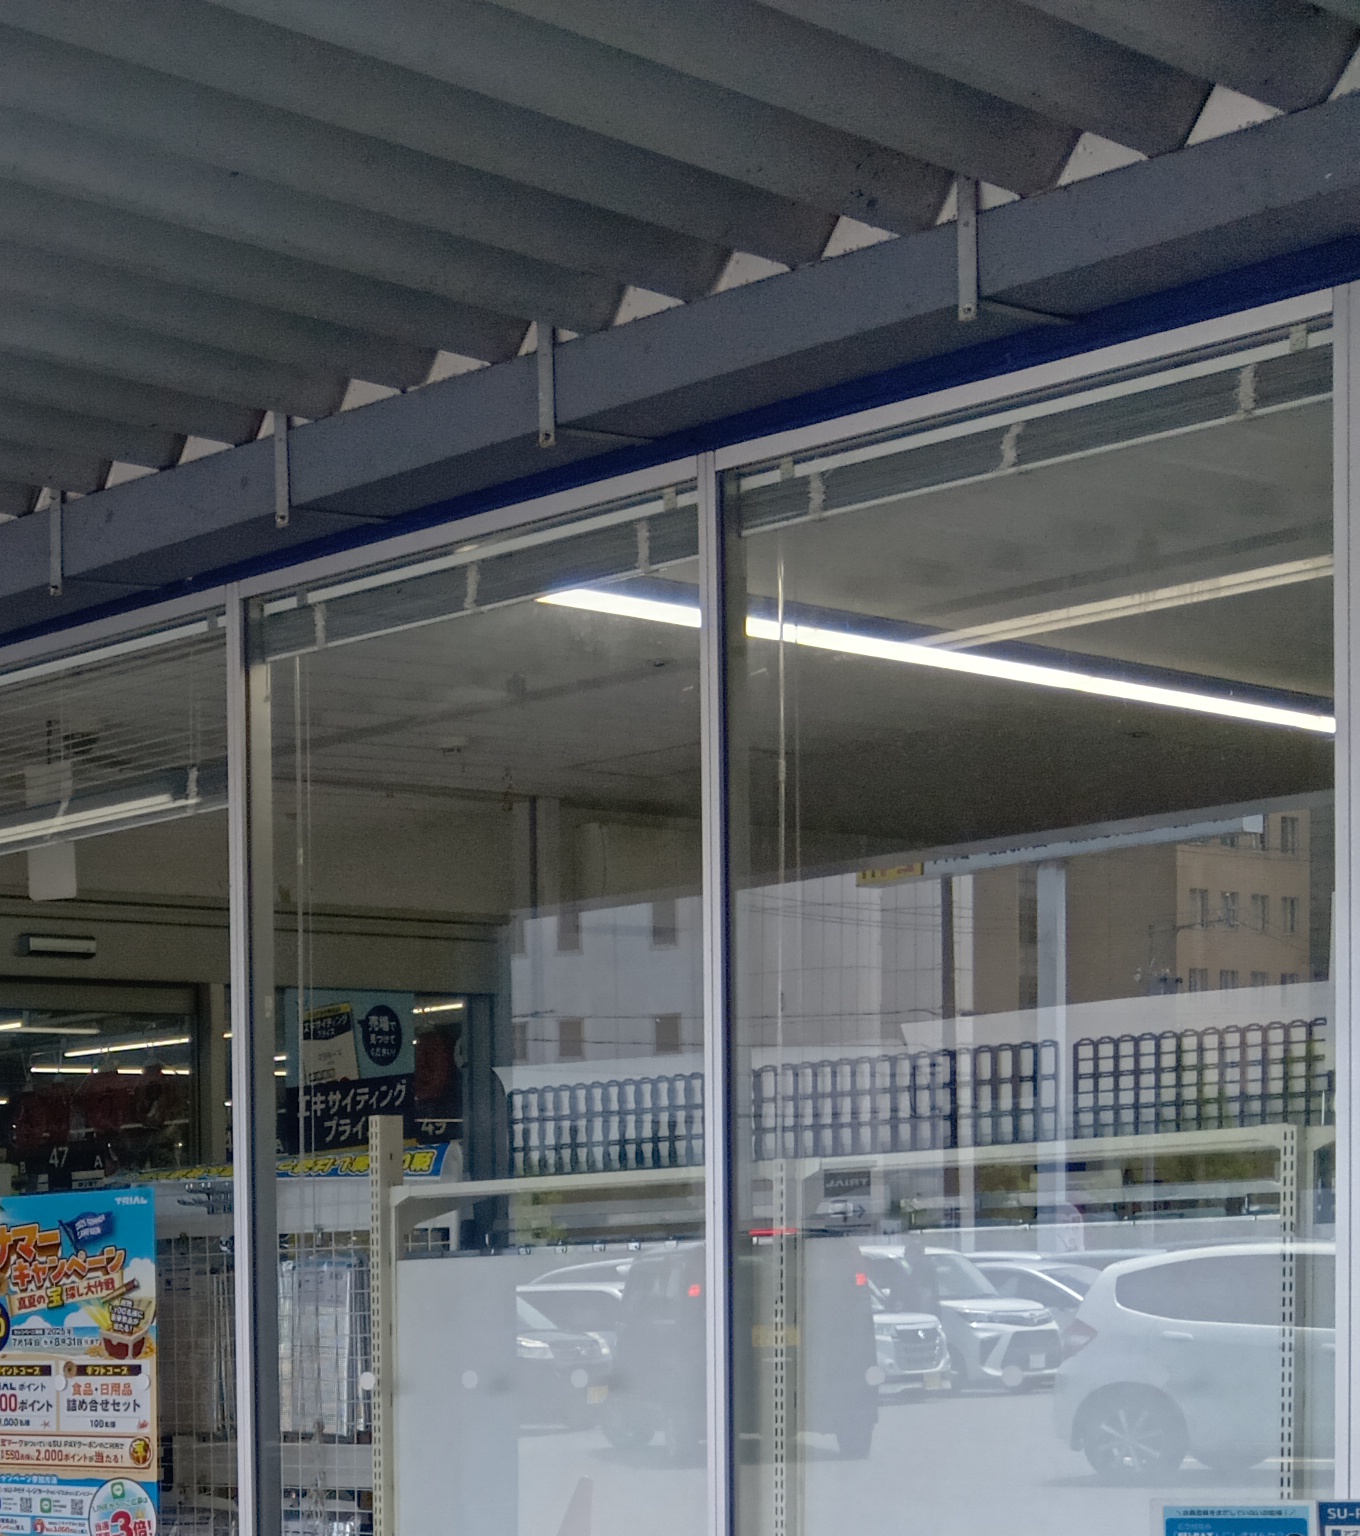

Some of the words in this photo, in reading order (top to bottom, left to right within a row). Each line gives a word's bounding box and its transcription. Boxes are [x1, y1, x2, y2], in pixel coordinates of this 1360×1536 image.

[368, 1015, 397, 1031] 売場で
[324, 1117, 369, 1142] プライ
[49, 1146, 69, 1168] 47
[94, 1155, 103, 1168] A
[115, 1196, 148, 1205] TRIAL
[12, 1246, 126, 1289] キャンペーン
[19, 1382, 46, 1392] ポイント
[71, 1382, 133, 1396] 食品・日用品
[66, 1398, 141, 1412] 詰め合せセット
